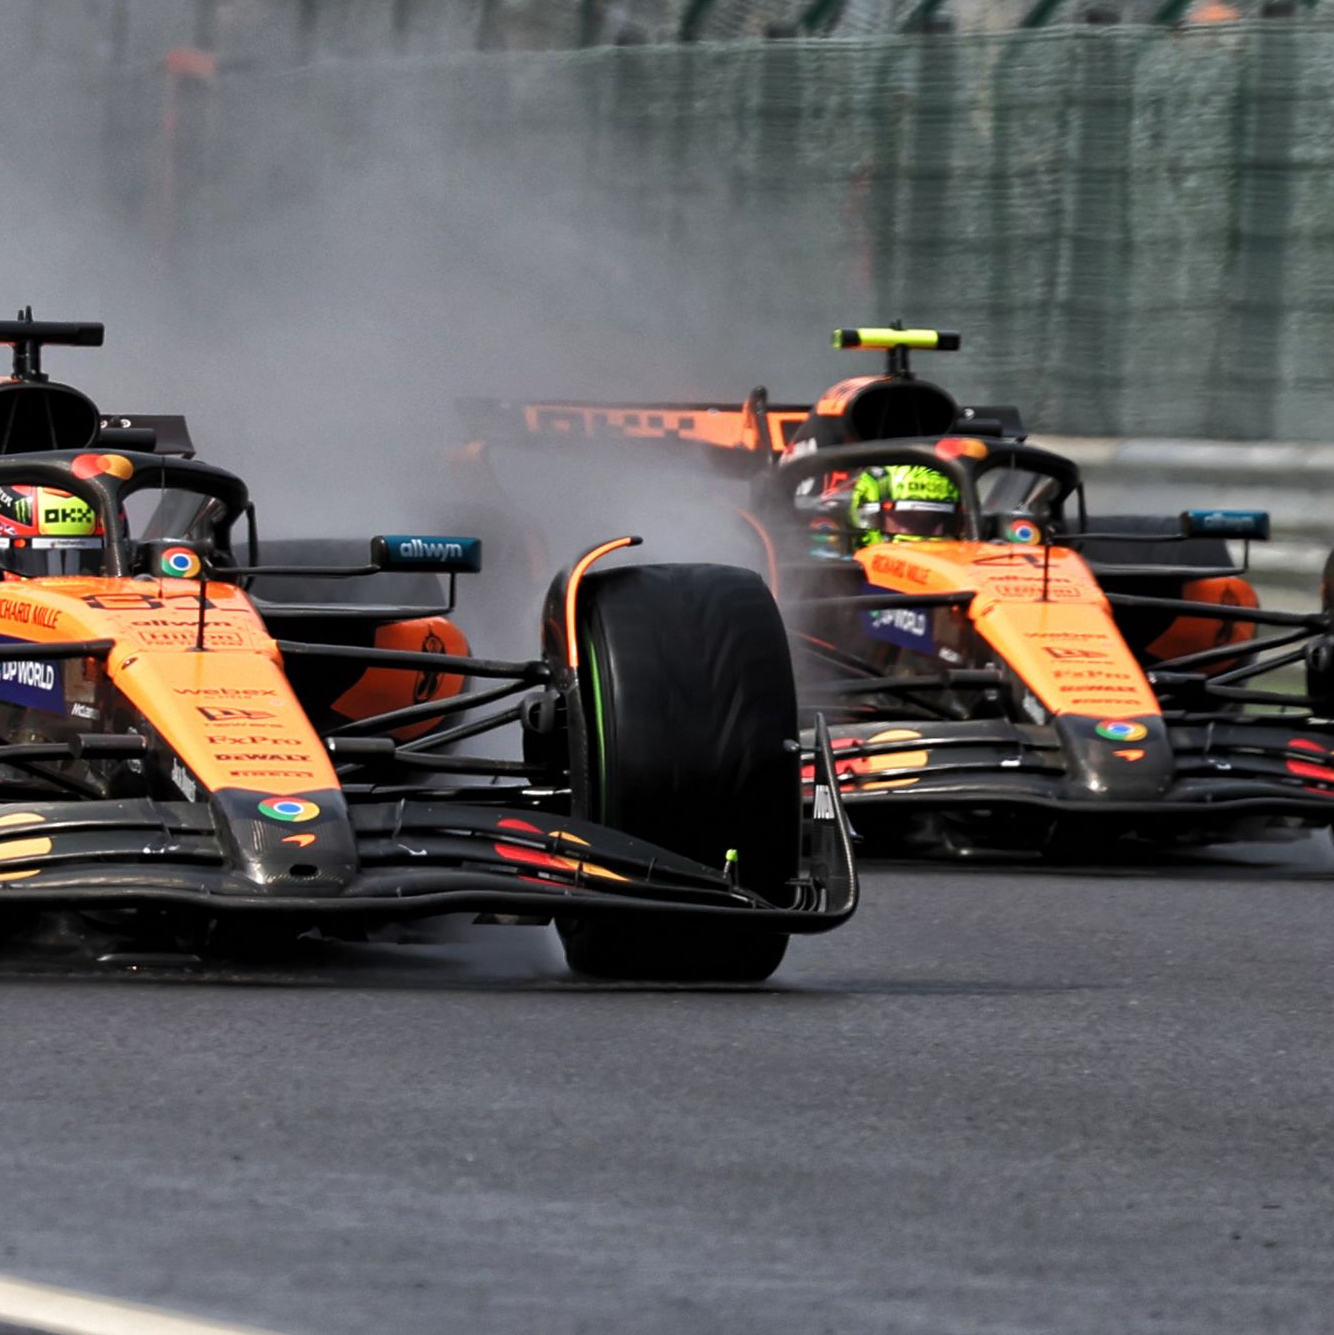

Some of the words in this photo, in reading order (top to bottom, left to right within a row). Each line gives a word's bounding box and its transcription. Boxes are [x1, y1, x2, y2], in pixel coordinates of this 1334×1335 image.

[44, 508, 92, 524] OKX
[399, 538, 464, 562] allwyn
[32, 605, 63, 630] MILLE
[18, 661, 55, 691] WORLD
[172, 687, 279, 697] webex
[206, 735, 303, 746] FxPro
